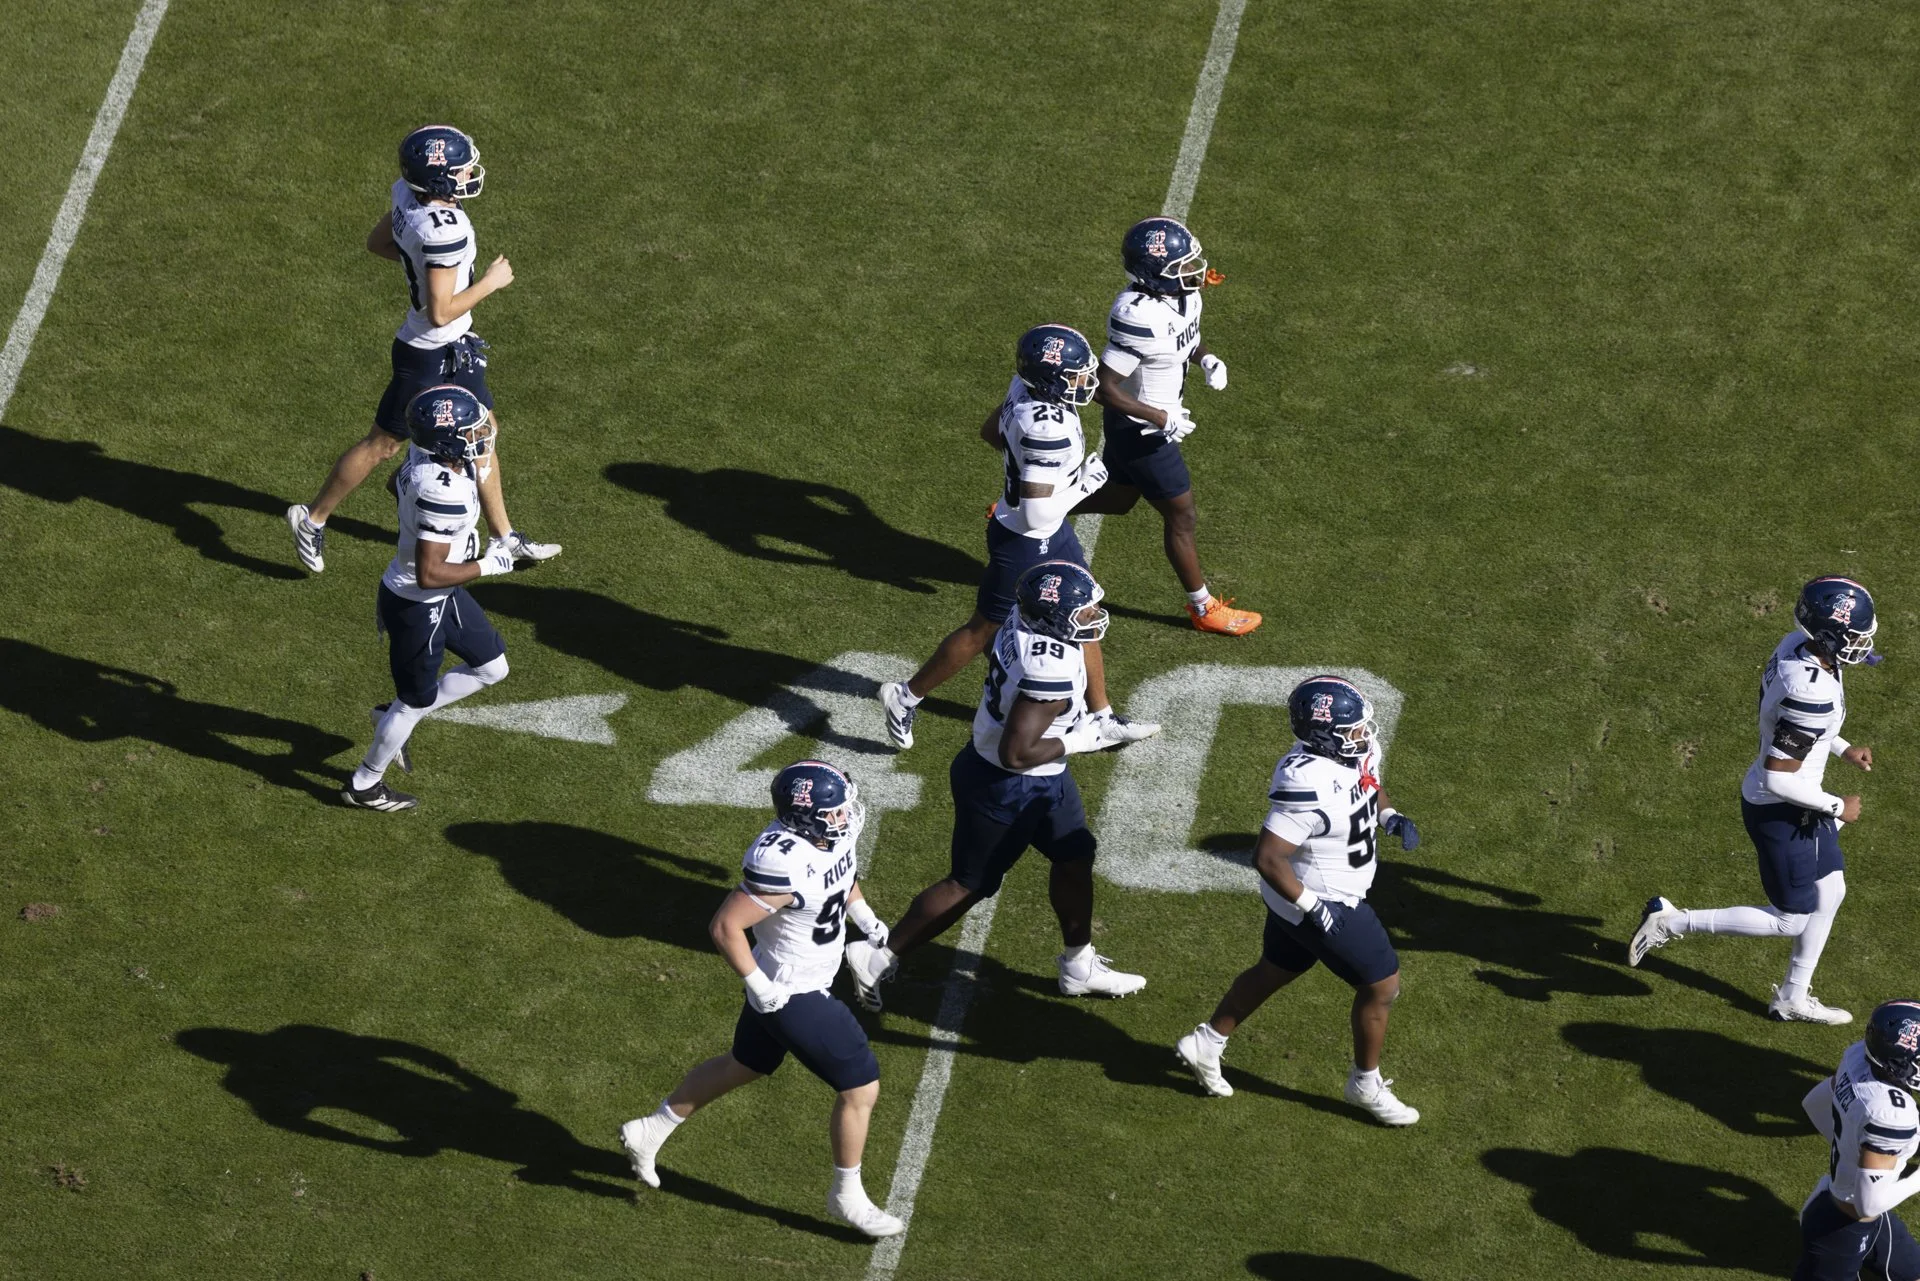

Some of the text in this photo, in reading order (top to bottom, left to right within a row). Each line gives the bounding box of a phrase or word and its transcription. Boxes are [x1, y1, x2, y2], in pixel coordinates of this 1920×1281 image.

[428, 209, 458, 229] 13
[1176, 316, 1200, 351] RICE
[1032, 404, 1065, 424] 23
[436, 471, 452, 487] 4
[1031, 641, 1065, 660] 99
[1804, 666, 1820, 683] 7
[1280, 754, 1317, 770] 57
[759, 832, 797, 856] 94
[823, 849, 853, 890] RICE
[812, 889, 847, 945] 9
[1888, 1088, 1906, 1108] 6
